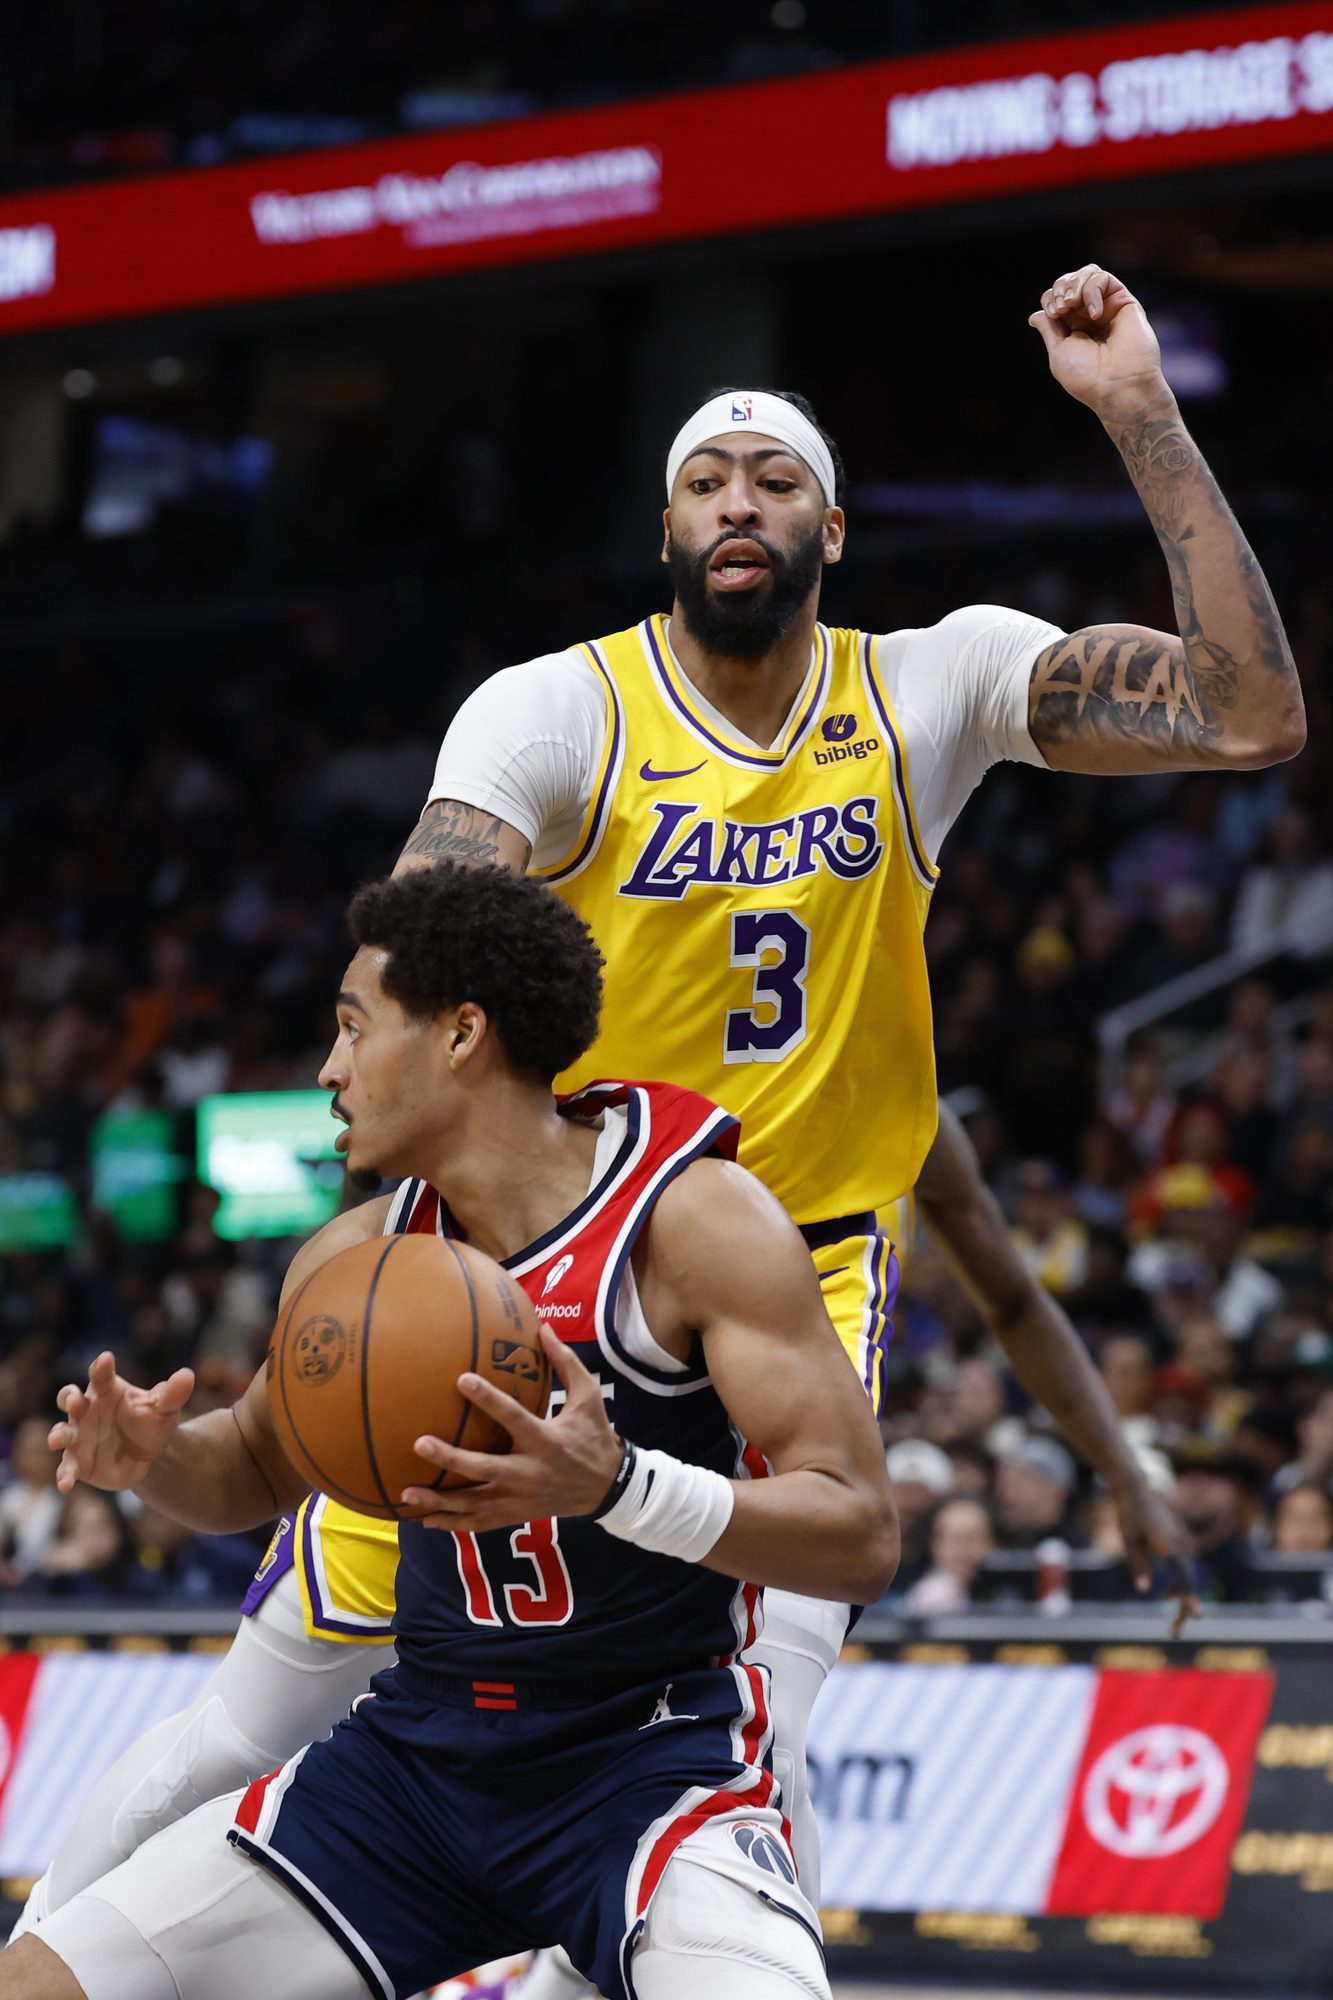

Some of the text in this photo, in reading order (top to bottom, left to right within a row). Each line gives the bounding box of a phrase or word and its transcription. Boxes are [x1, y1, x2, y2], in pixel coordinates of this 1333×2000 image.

[813, 736, 880, 767] bibigo
[616, 795, 886, 902] LAKERS
[722, 908, 812, 1065] 3
[451, 1514, 575, 1628] 13
